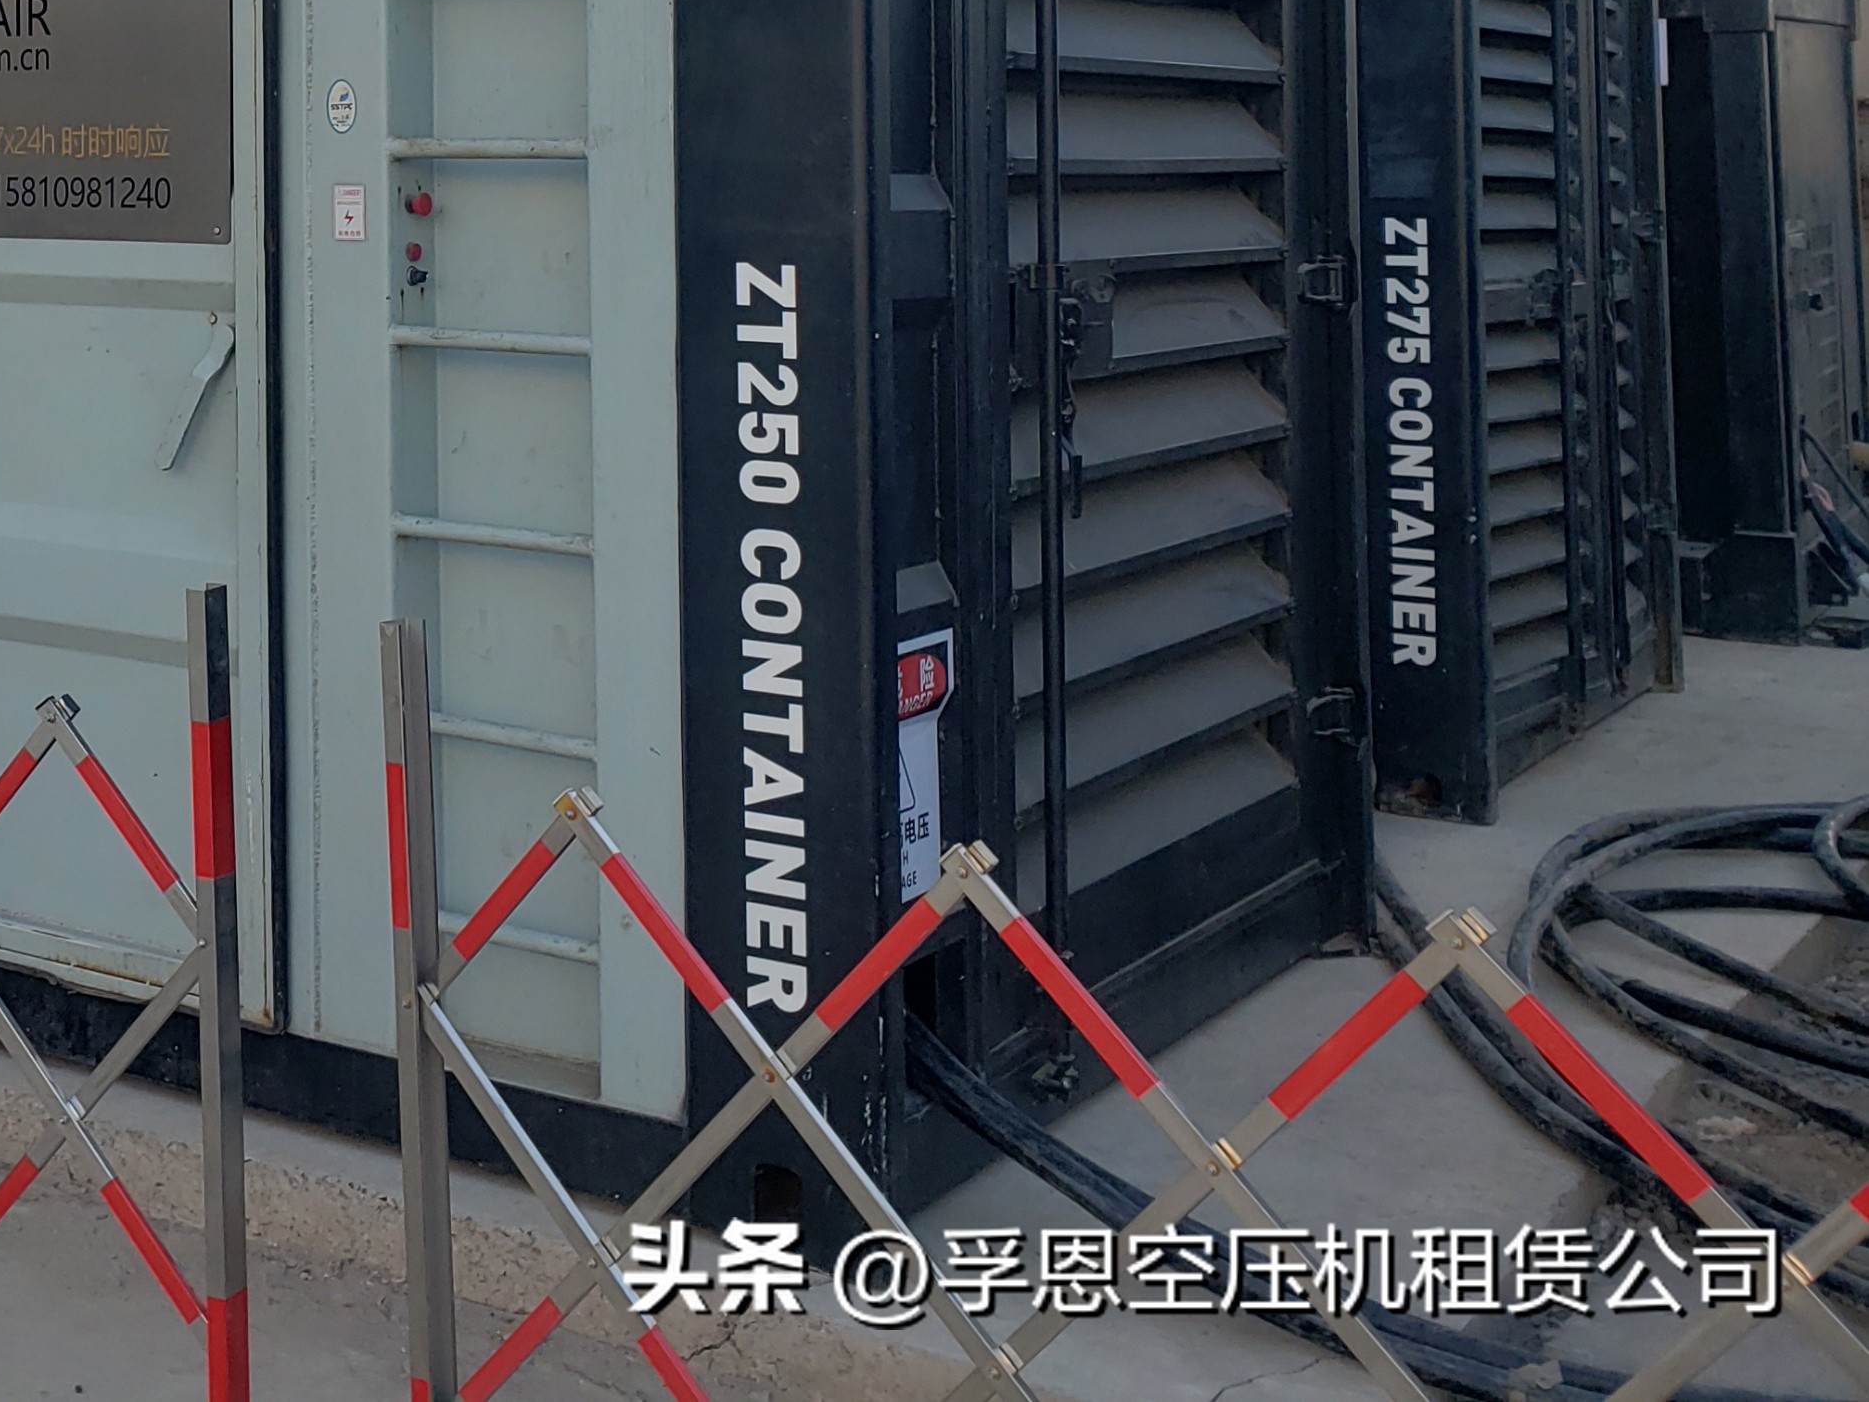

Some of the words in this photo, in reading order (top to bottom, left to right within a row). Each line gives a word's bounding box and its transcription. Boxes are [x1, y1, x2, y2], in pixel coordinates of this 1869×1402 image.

[61, 124, 170, 159] 时时响应
[734, 262, 800, 505] ZT250
[1384, 217, 1430, 364] ZT275
[1388, 377, 1437, 668] CONTAINER
[740, 528, 808, 1015] CONTAINER
[900, 811, 930, 848] 电压
